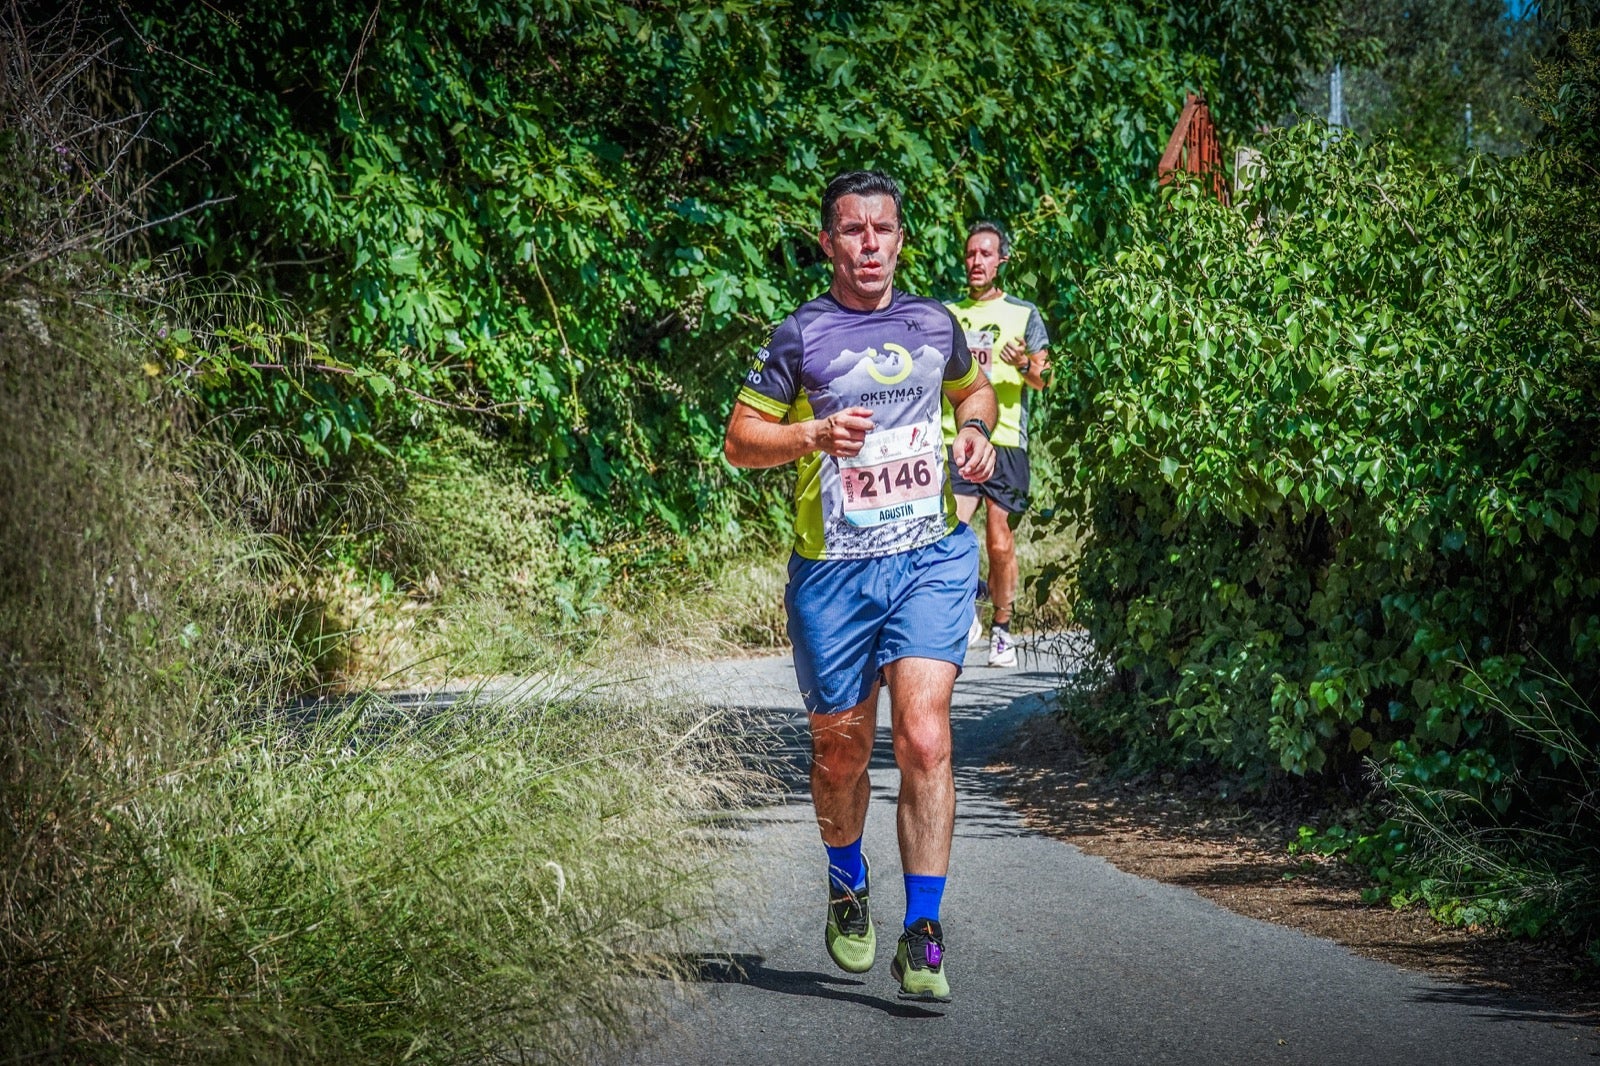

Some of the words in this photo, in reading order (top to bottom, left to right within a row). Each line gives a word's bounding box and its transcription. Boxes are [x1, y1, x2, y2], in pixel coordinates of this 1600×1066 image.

[860, 386, 923, 402] OKEYMAS
[858, 459, 931, 498] 2146
[879, 502, 914, 521] AGUSTÍN
